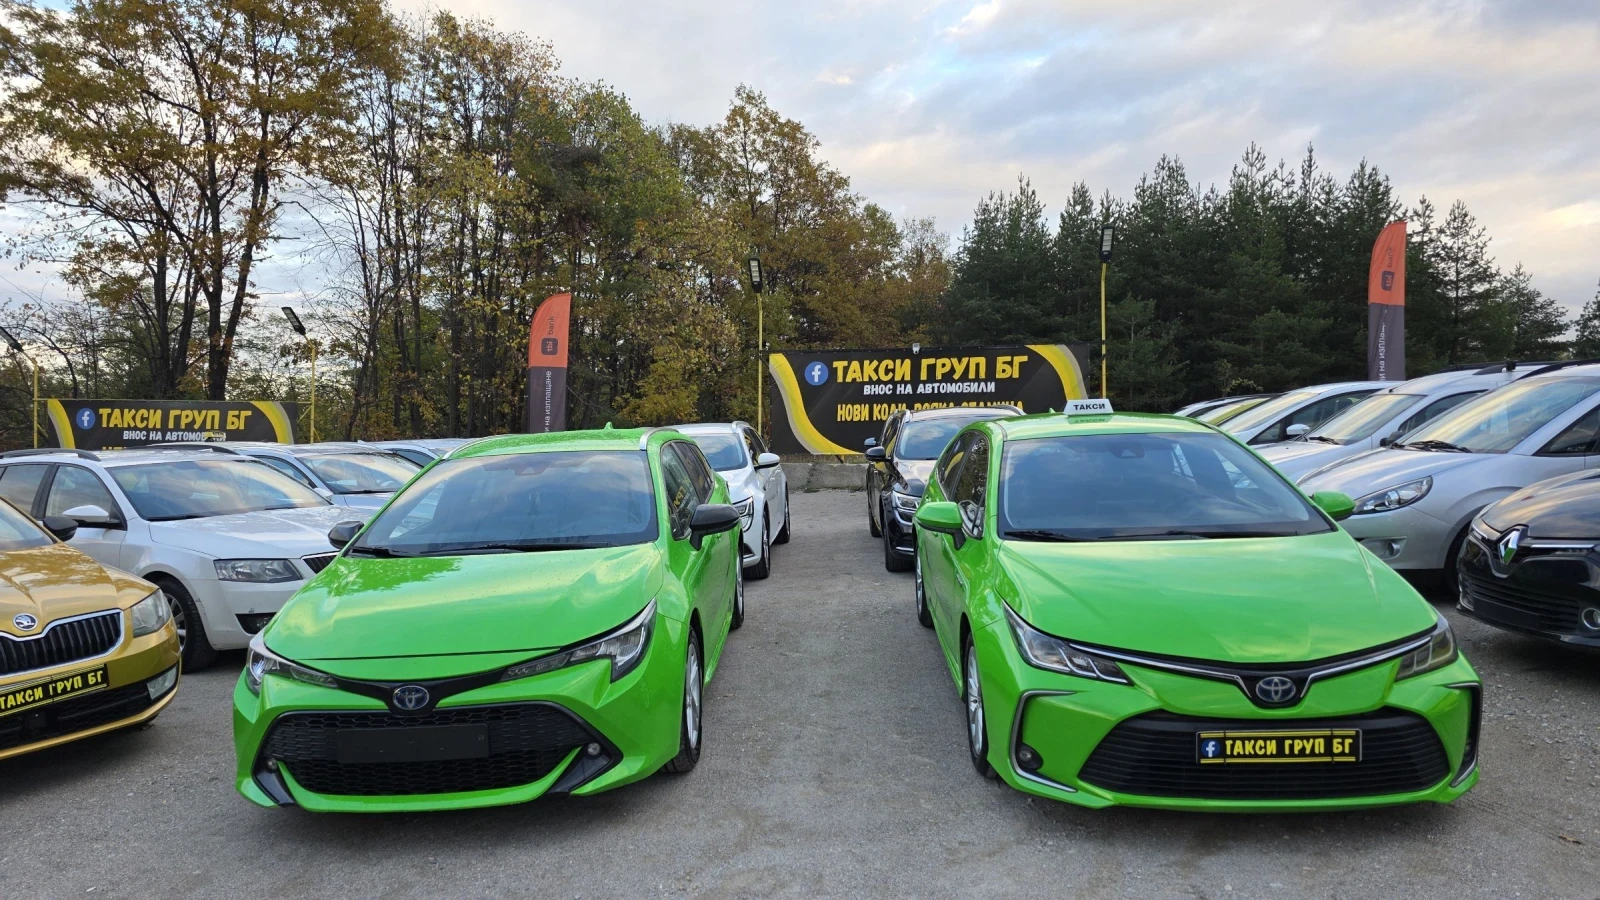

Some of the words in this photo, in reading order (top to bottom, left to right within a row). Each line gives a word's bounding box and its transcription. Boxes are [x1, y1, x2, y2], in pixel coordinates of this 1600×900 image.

[832, 359, 911, 383] ТАКСИ
[920, 356, 987, 381] ГРУП
[995, 355, 1029, 379] БГ
[1379, 360, 1385, 371] на
[863, 383, 893, 395] ВНОС
[896, 383, 913, 394] НА
[916, 381, 996, 394] АВТОМОБИЛИ
[837, 403, 869, 422] НОВИ
[1073, 403, 1106, 411] ТАКСИ
[98, 408, 163, 429] ТАКСИ
[168, 409, 220, 430] ГРУП
[226, 410, 253, 430] БГ
[545, 416, 551, 426] на
[123, 431, 147, 440] ВНОС
[149, 431, 163, 441] НА
[0, 686, 43, 710] ТАКСИ
[49, 675, 83, 696] ГРУП
[87, 670, 104, 685] БГ
[1225, 739, 1277, 756] ТАКСИ
[1284, 738, 1325, 755] ГРУП
[1332, 738, 1353, 754] БГ
